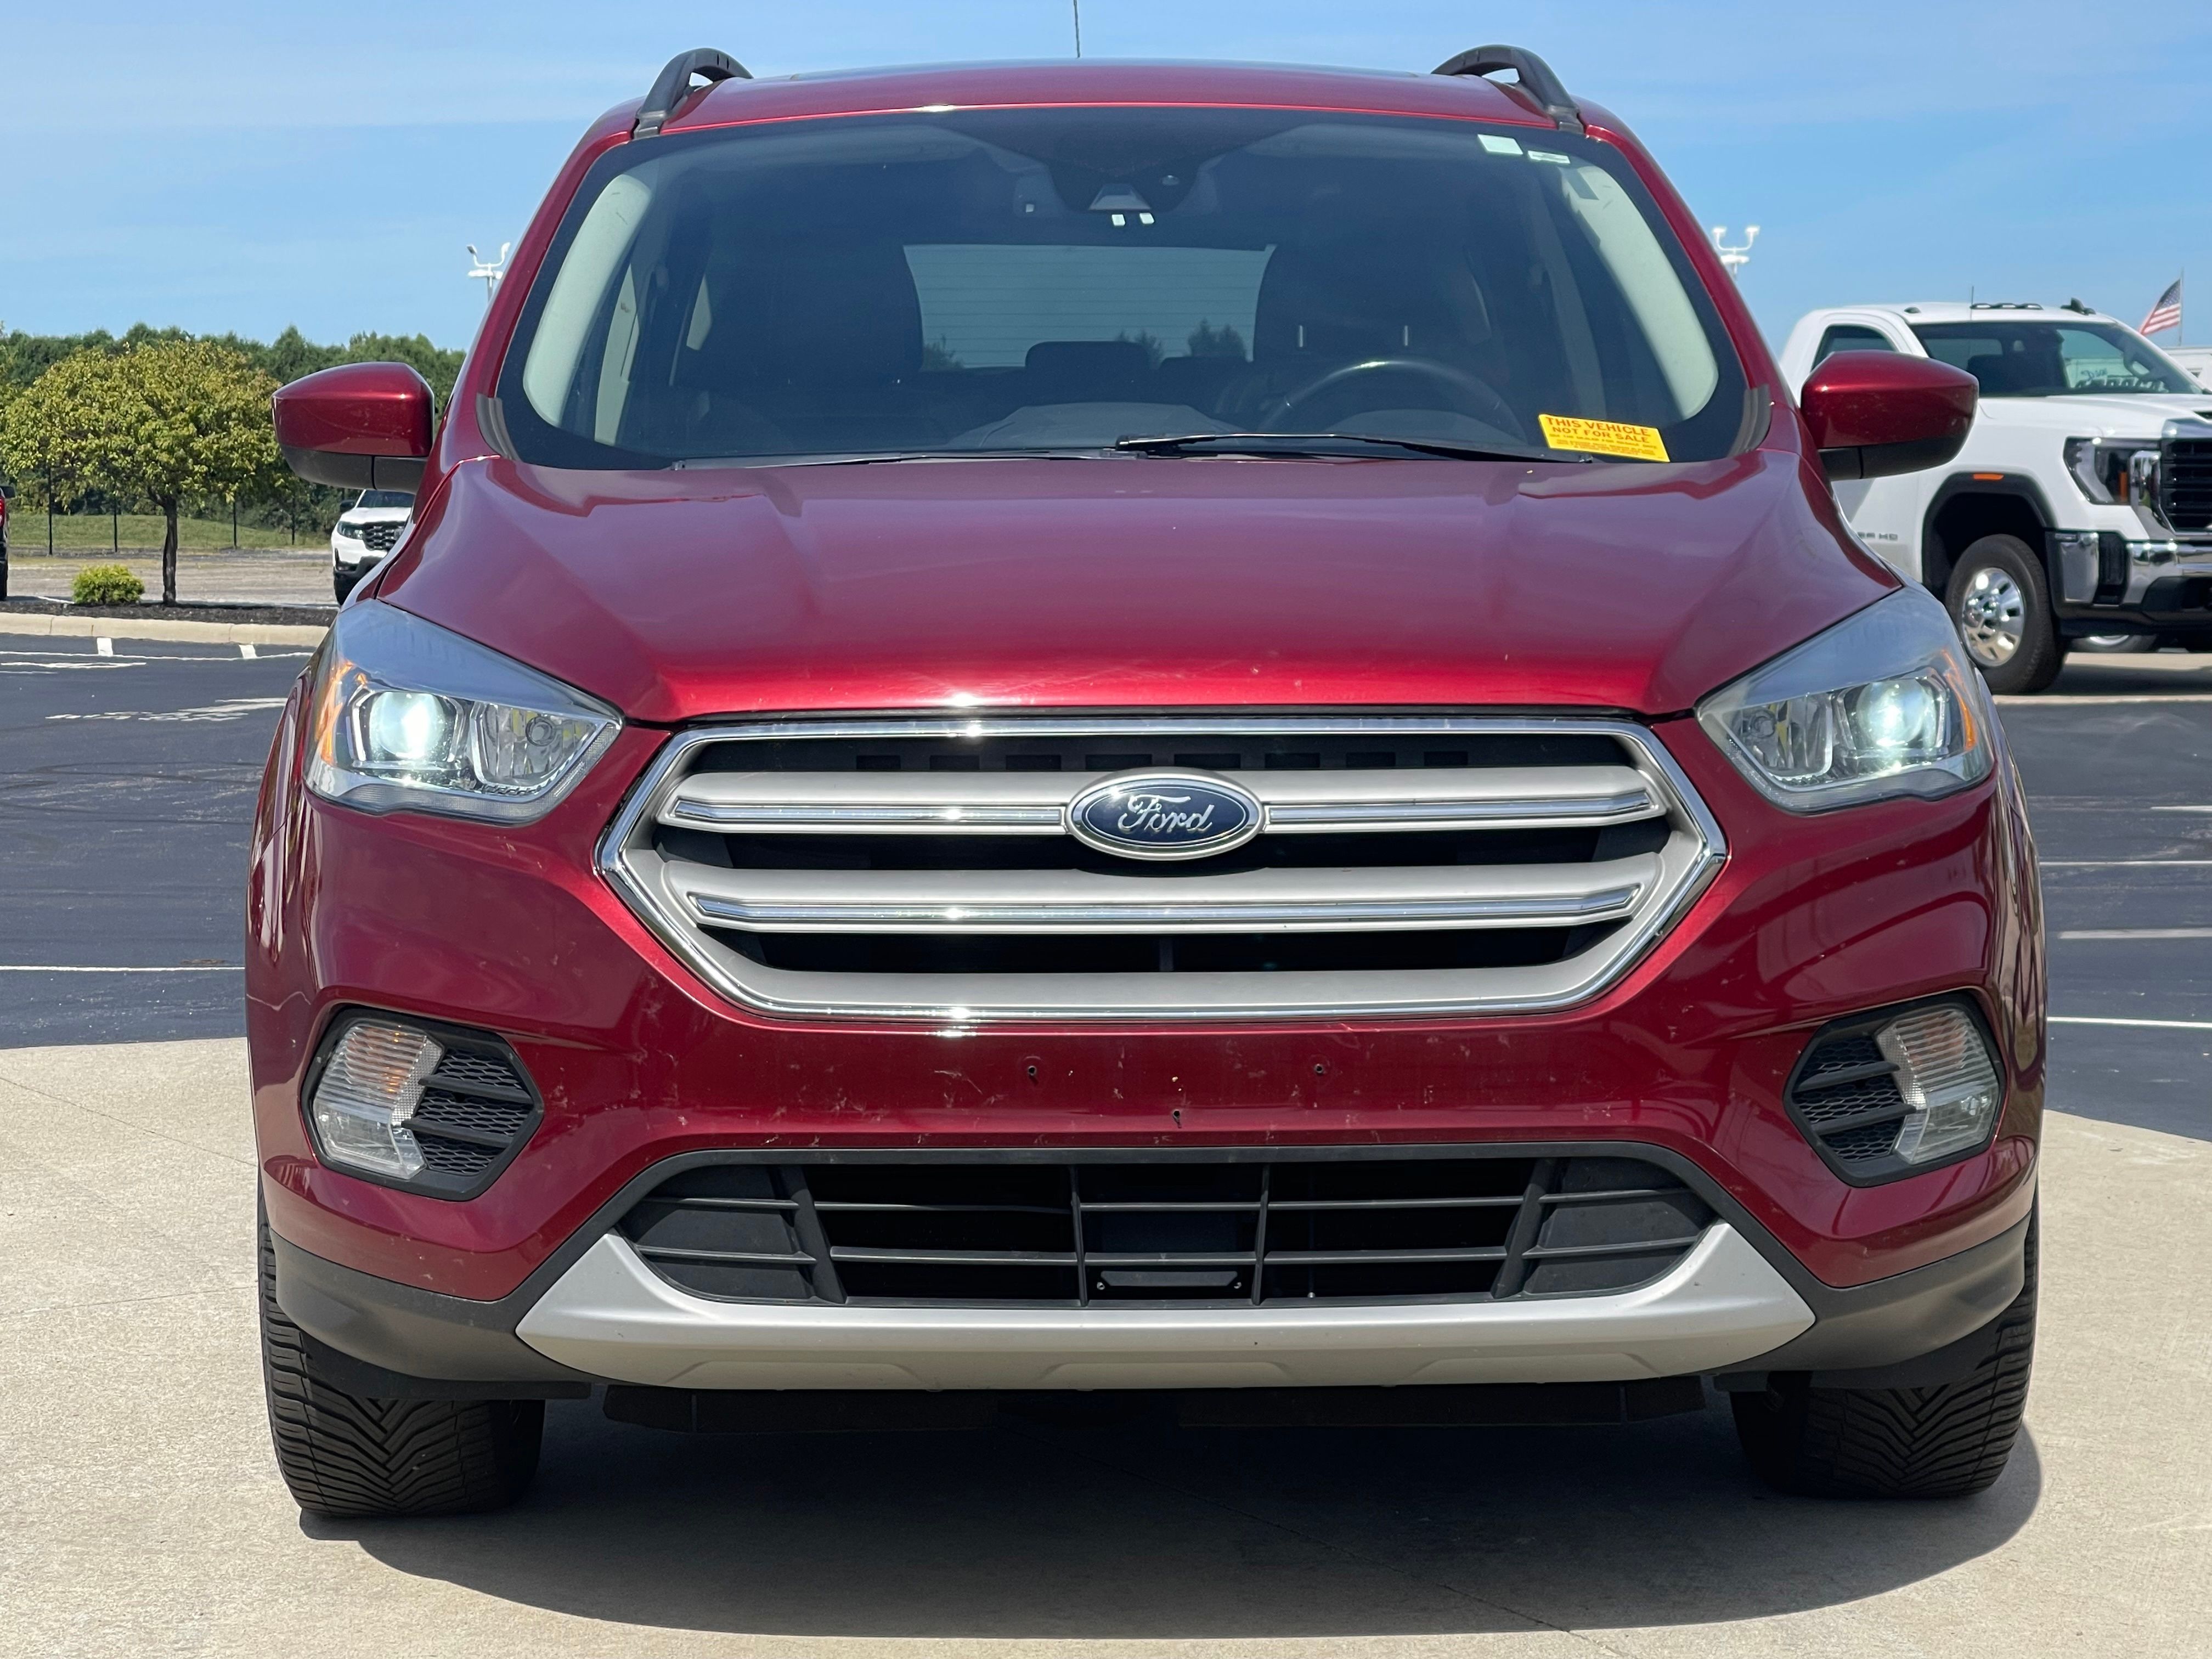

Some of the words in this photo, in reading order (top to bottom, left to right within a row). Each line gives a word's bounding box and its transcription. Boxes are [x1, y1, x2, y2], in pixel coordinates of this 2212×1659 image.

[1545, 416, 1582, 427] THIS
[1584, 421, 1651, 437] VEHICLE
[1583, 430, 1611, 438] FOR
[1615, 433, 1650, 443] SALE
[1118, 794, 1215, 834] Ford
